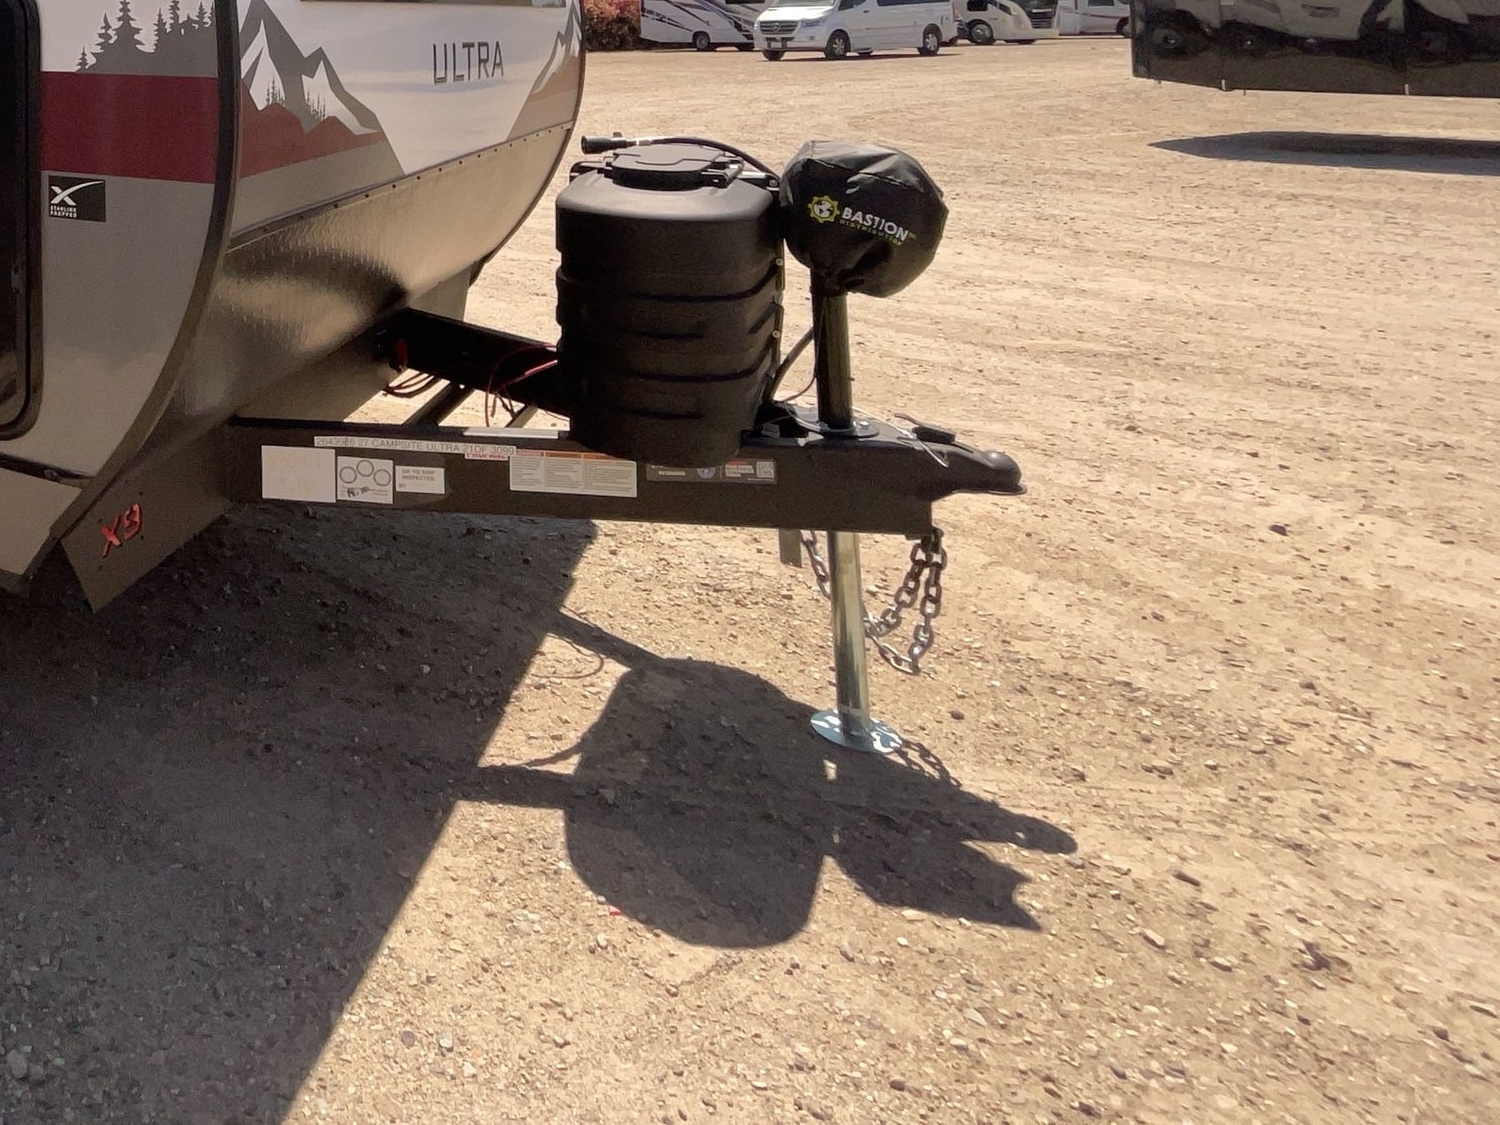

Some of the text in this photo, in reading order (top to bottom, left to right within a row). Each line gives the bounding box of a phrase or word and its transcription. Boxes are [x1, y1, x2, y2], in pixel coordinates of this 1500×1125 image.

[433, 41, 505, 85] ULTRA
[842, 207, 908, 241] BASTION
[371, 439, 424, 450] CAMPSITE
[426, 442, 461, 452] ULTRA
[491, 445, 515, 455] 3099
